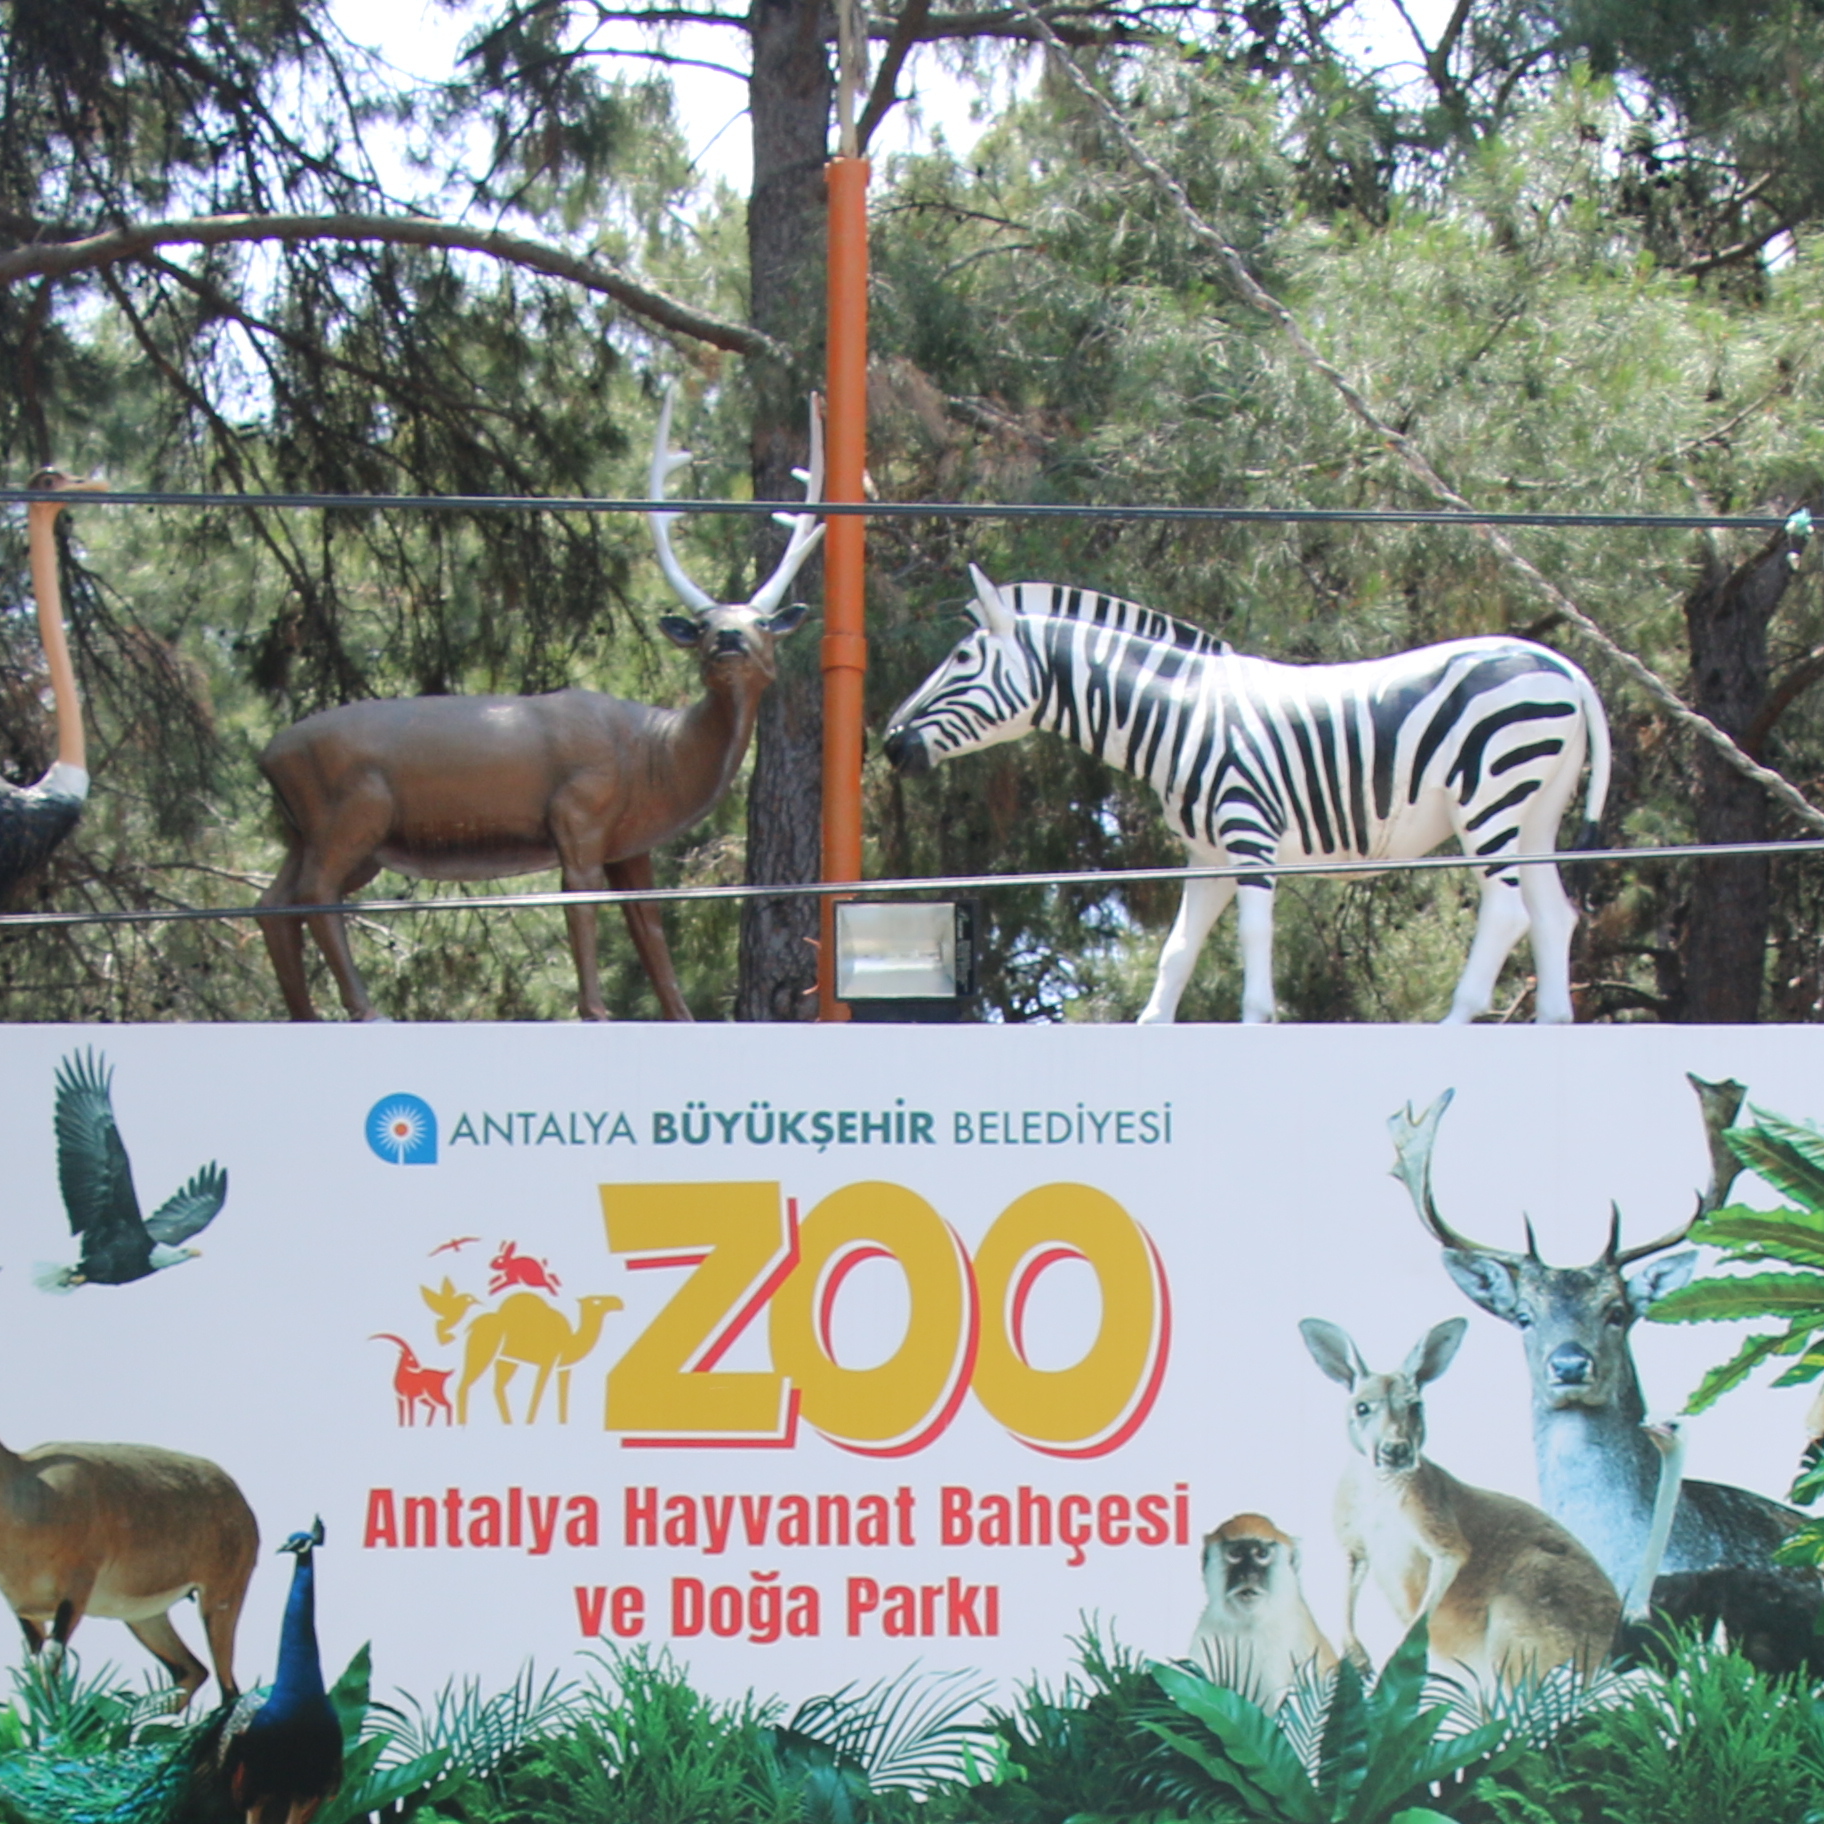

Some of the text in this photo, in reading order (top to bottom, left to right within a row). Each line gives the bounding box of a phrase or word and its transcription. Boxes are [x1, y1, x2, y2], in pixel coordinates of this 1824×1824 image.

[449, 1099, 1173, 1153] ANTALYA BÜYÜKŞEHİR BELEDİYESİ
[597, 1180, 1172, 1460] ZOO
[363, 1483, 1190, 1567] Antalya Hayvanat Bahçesi
[576, 1571, 1000, 1644] ve Doğa Parkı
